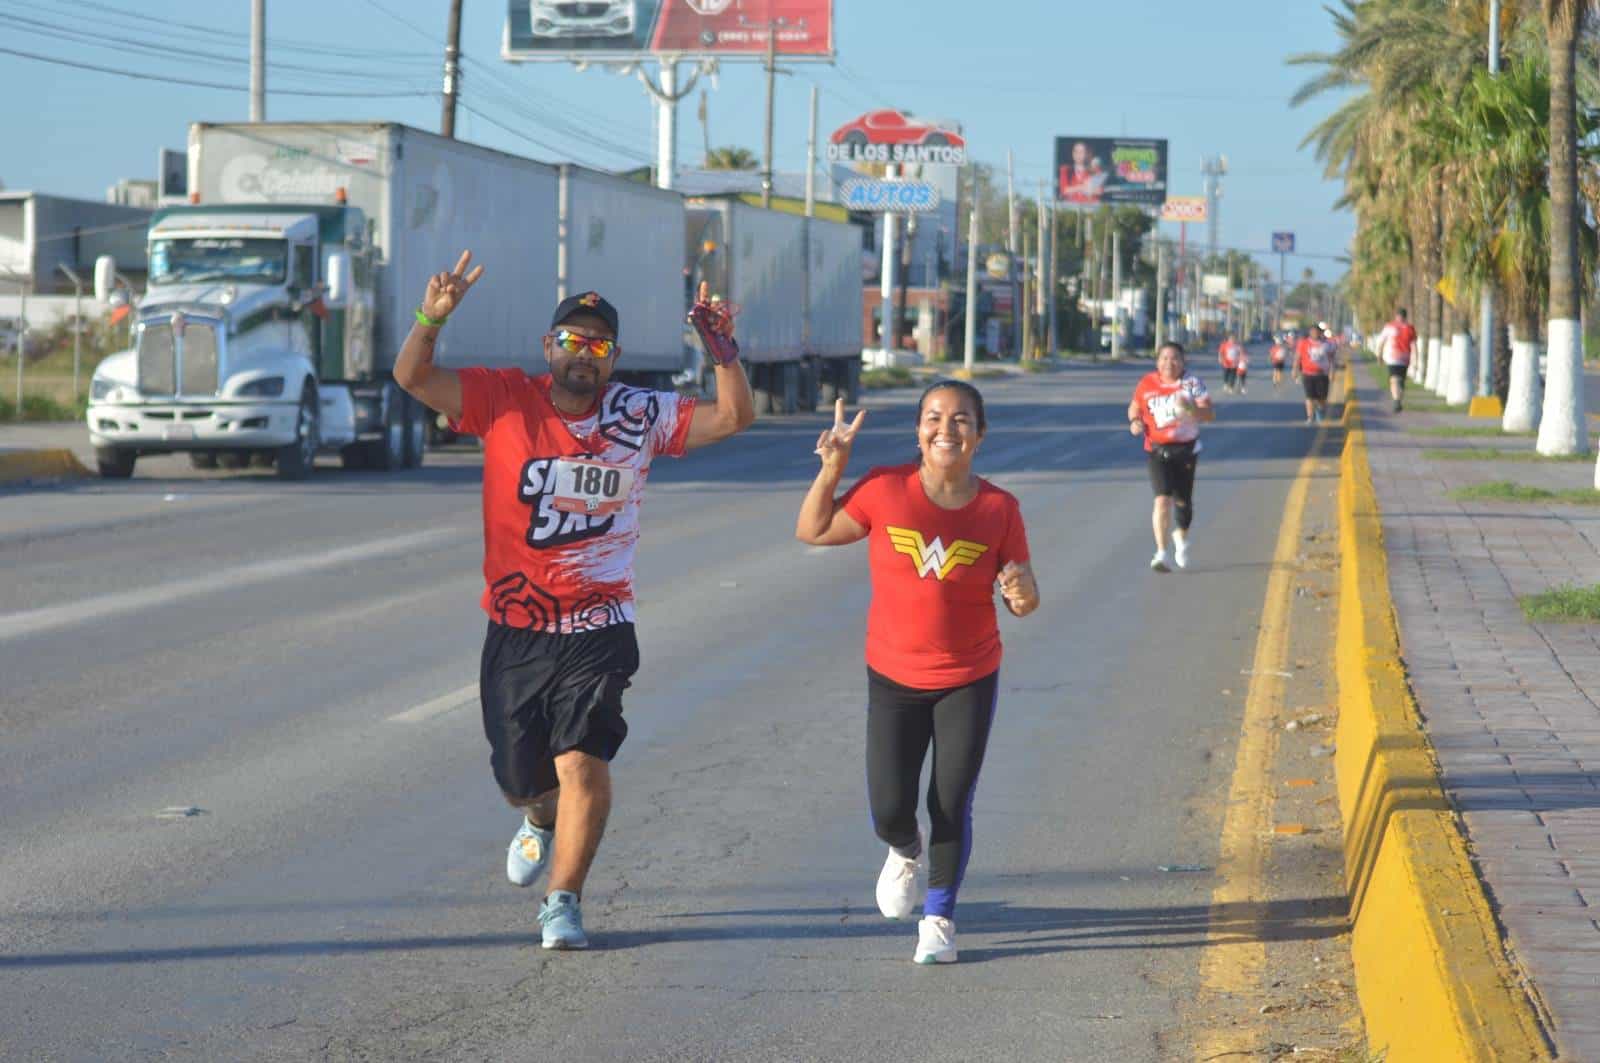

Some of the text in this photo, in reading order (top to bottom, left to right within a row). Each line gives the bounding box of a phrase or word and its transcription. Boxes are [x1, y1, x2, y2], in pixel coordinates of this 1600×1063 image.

[828, 144, 963, 164] DE LOS SANTOS
[851, 185, 929, 205] AUTOS
[571, 465, 620, 498] 180
